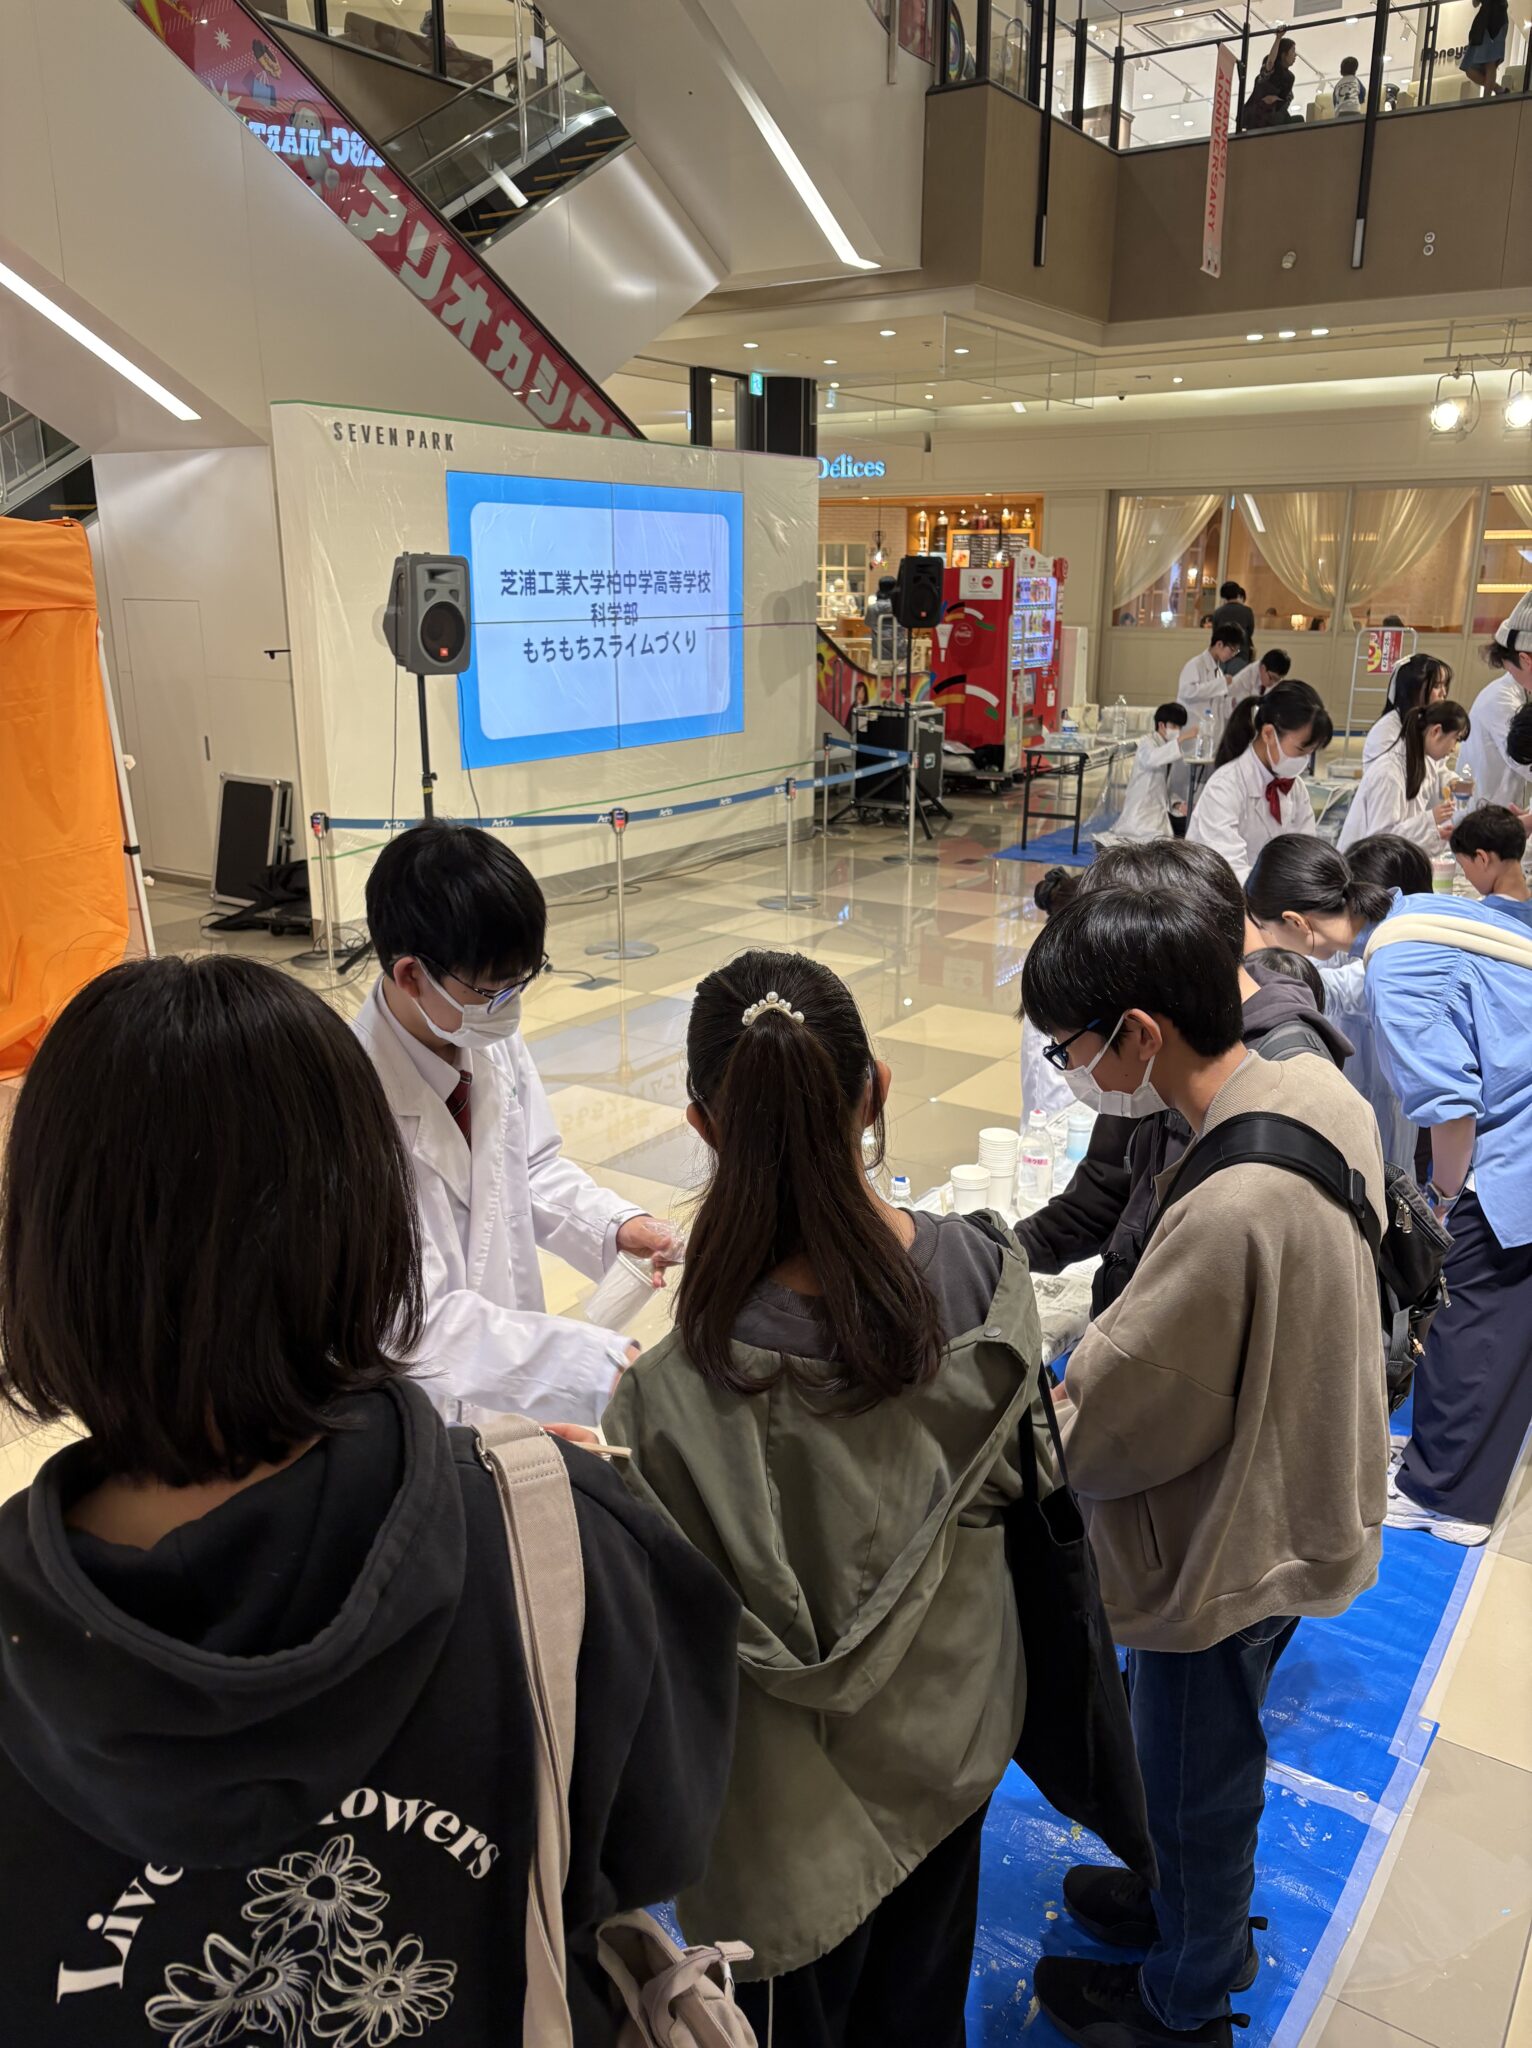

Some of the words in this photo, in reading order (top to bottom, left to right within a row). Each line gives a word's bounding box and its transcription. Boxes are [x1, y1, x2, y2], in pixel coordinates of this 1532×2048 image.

[1421, 45, 1469, 60] neys
[1219, 78, 1231, 179] THANKS!
[1208, 67, 1225, 232] ANNIVERSARY
[347, 168, 635, 440] アリオカシワ
[333, 422, 398, 446] SEVEN
[406, 429, 453, 452] PARK
[816, 453, 886, 480] Délices
[500, 569, 712, 597] 芝浦工業大学柏中学高等学校
[590, 601, 638, 628] 科学部
[523, 630, 697, 663] もちもちスライムづくり
[56, 1861, 184, 2004] Live
[317, 1786, 500, 1880] owers
